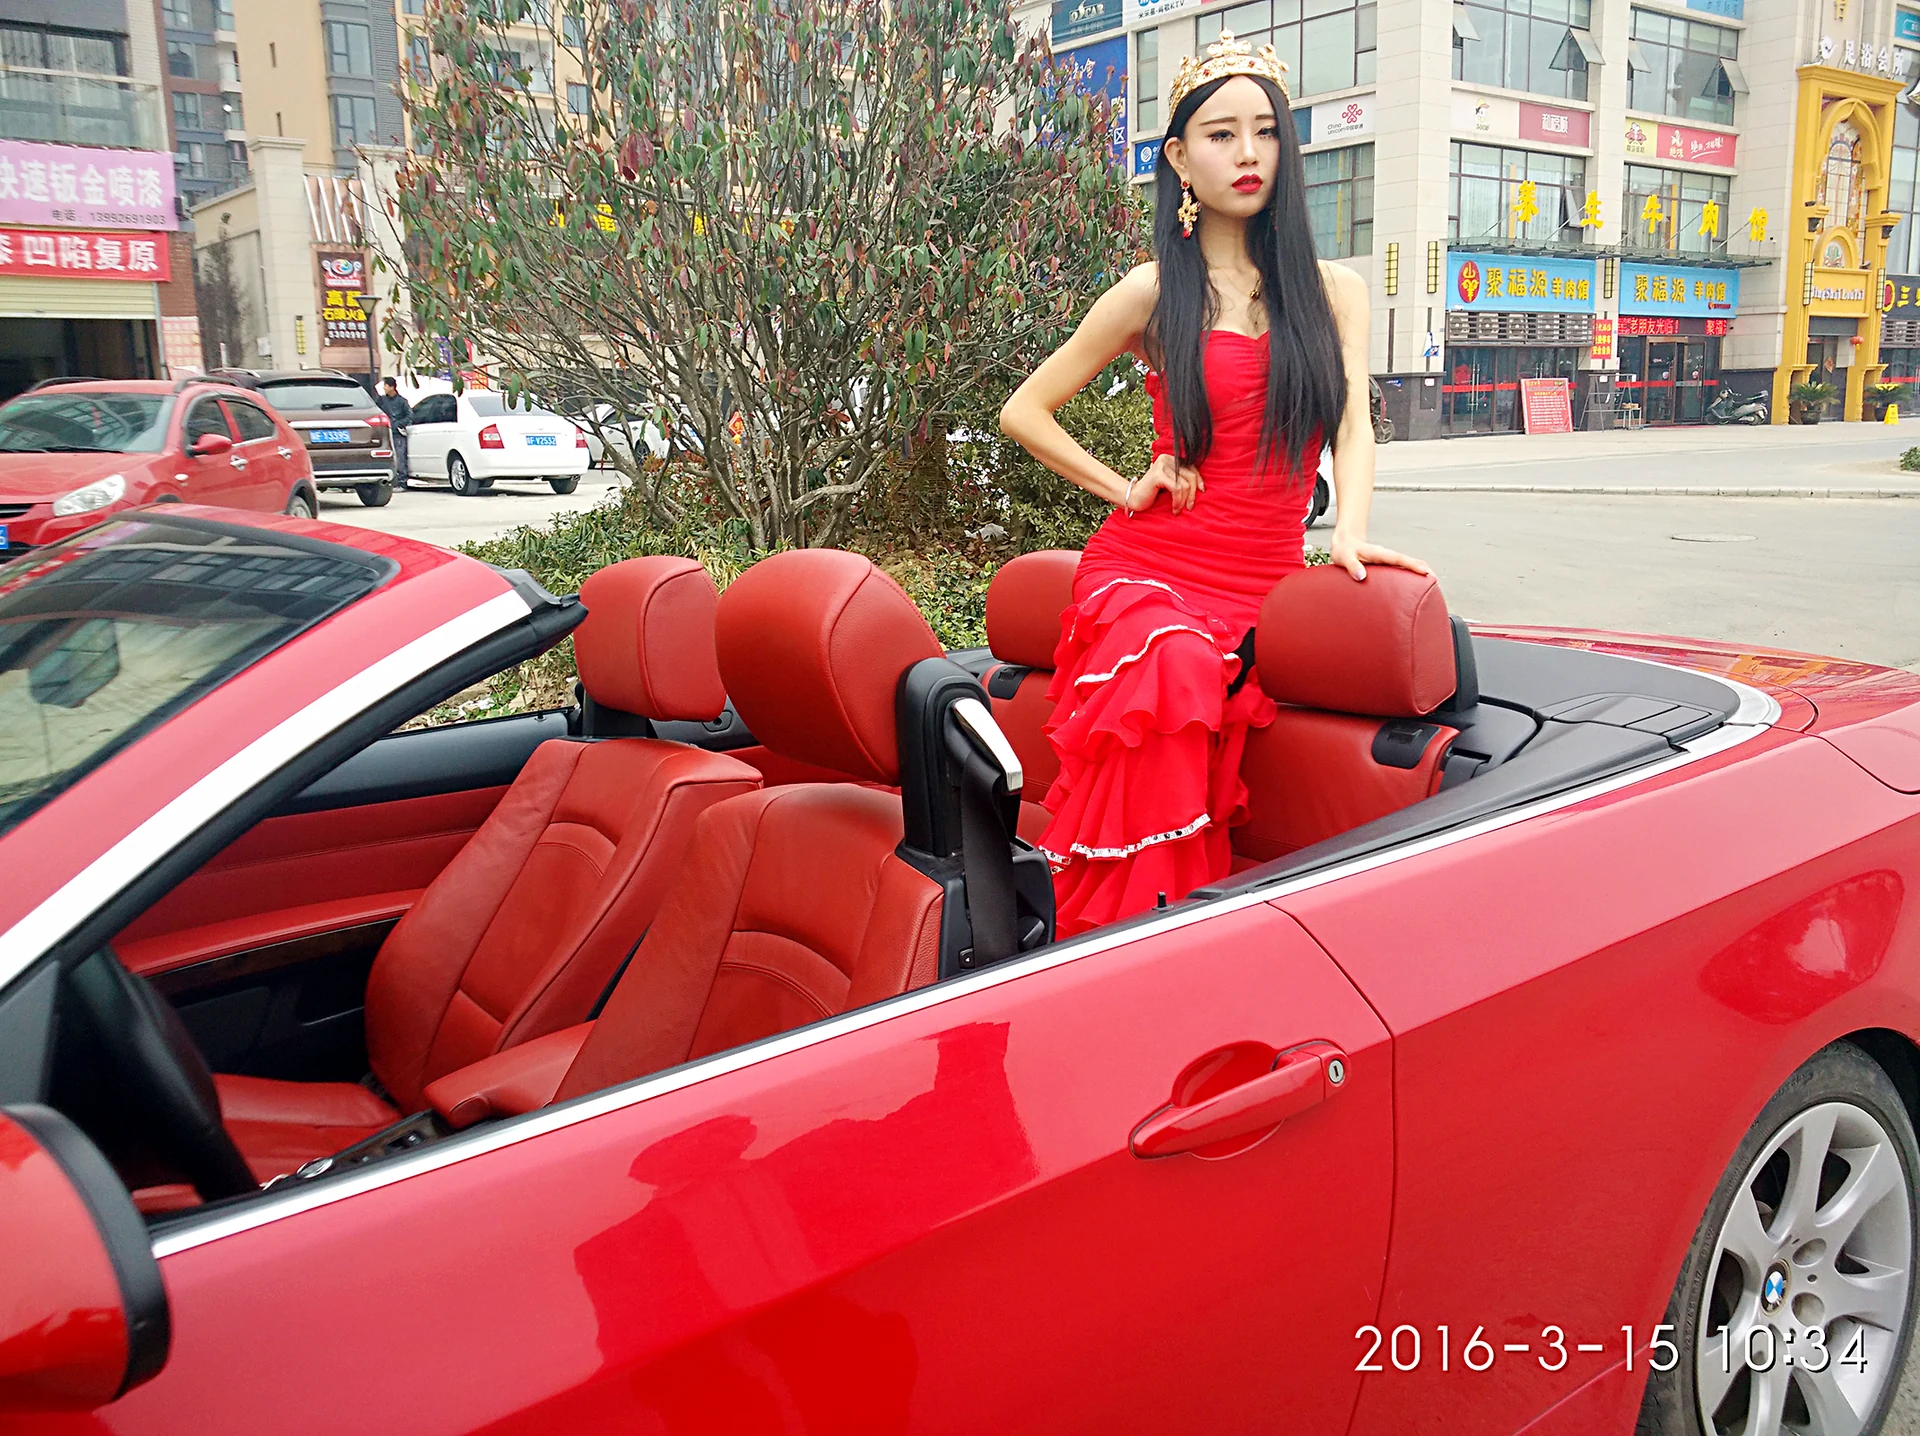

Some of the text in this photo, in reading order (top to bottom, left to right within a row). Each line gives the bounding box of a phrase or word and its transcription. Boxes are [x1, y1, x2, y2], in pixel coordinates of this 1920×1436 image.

[23, 235, 158, 272] 凹陷复原
[1485, 267, 1590, 301] 聚福源 羊肉馆
[1634, 274, 1727, 303] 聚福源 羊肉馆
